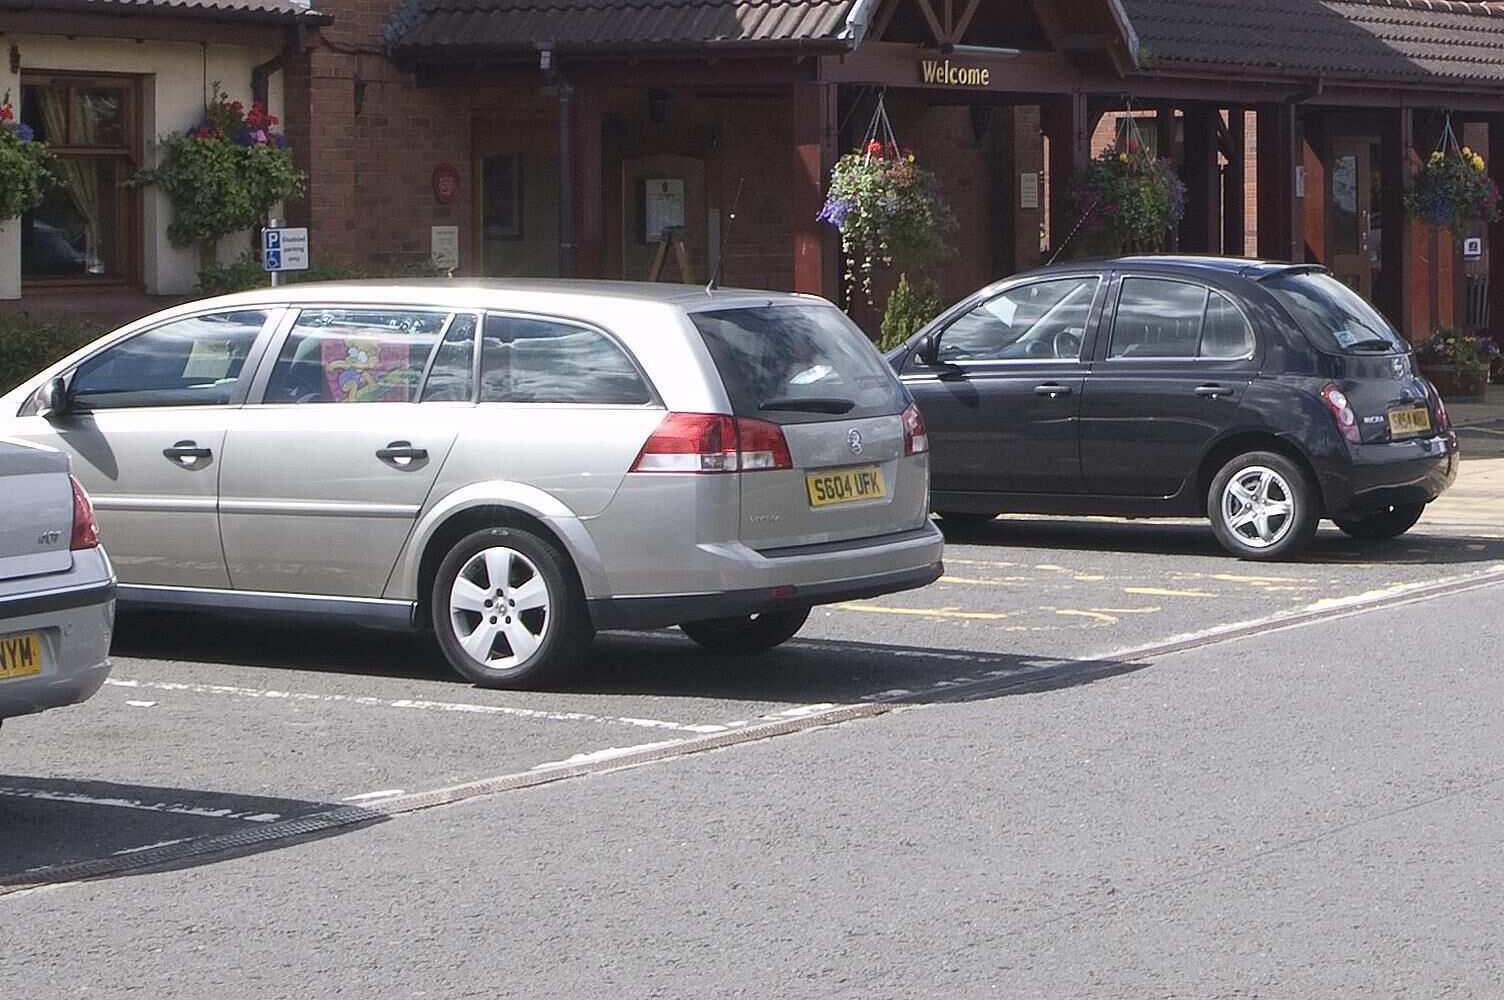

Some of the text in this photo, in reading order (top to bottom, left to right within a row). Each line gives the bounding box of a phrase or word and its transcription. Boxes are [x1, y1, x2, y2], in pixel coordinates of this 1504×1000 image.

[922, 59, 990, 86] Welcome
[268, 232, 279, 248] P
[814, 471, 881, 501] SG04 UFK
